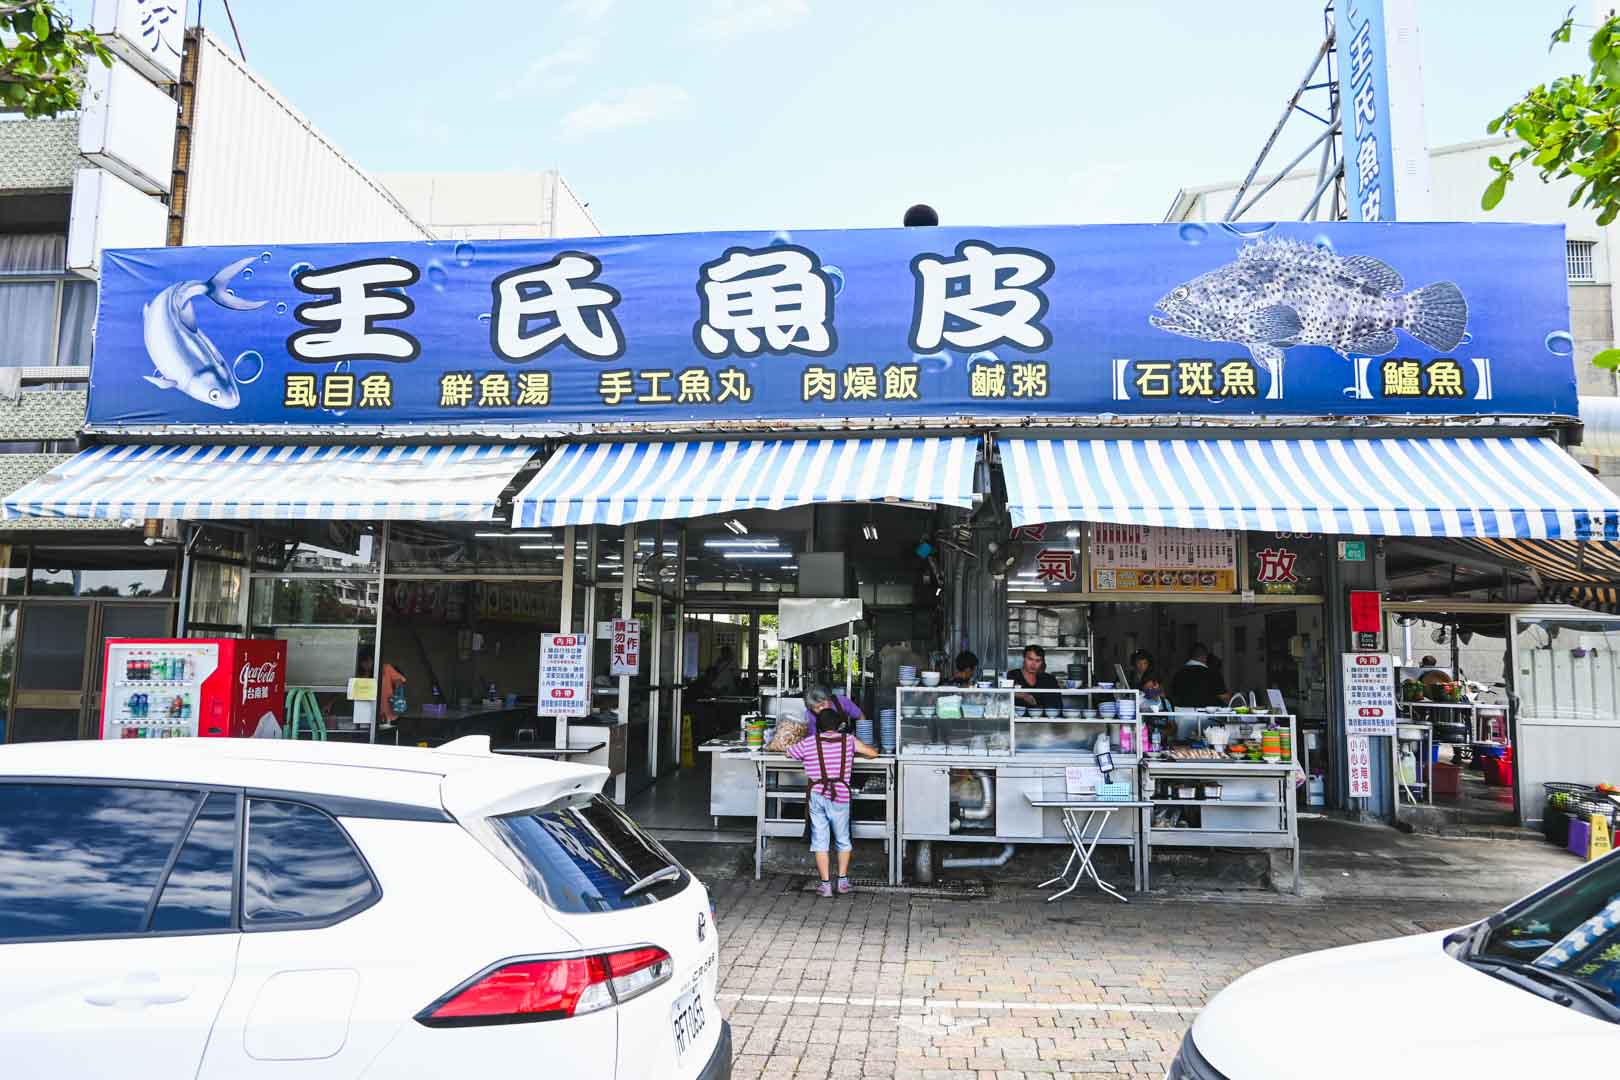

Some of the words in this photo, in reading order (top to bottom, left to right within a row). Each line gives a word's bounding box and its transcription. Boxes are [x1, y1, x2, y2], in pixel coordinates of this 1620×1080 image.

[287, 240, 1054, 362] 王氏魚皮
[285, 374, 392, 408] 虱目魚
[442, 373, 550, 405] 鮮魚湯
[603, 370, 752, 405] 手工魚丸
[806, 366, 918, 401] 肉燥飯
[972, 363, 1047, 396] 鹹粥
[613, 620, 626, 666] 請勿進入
[626, 622, 639, 666] 工作區
